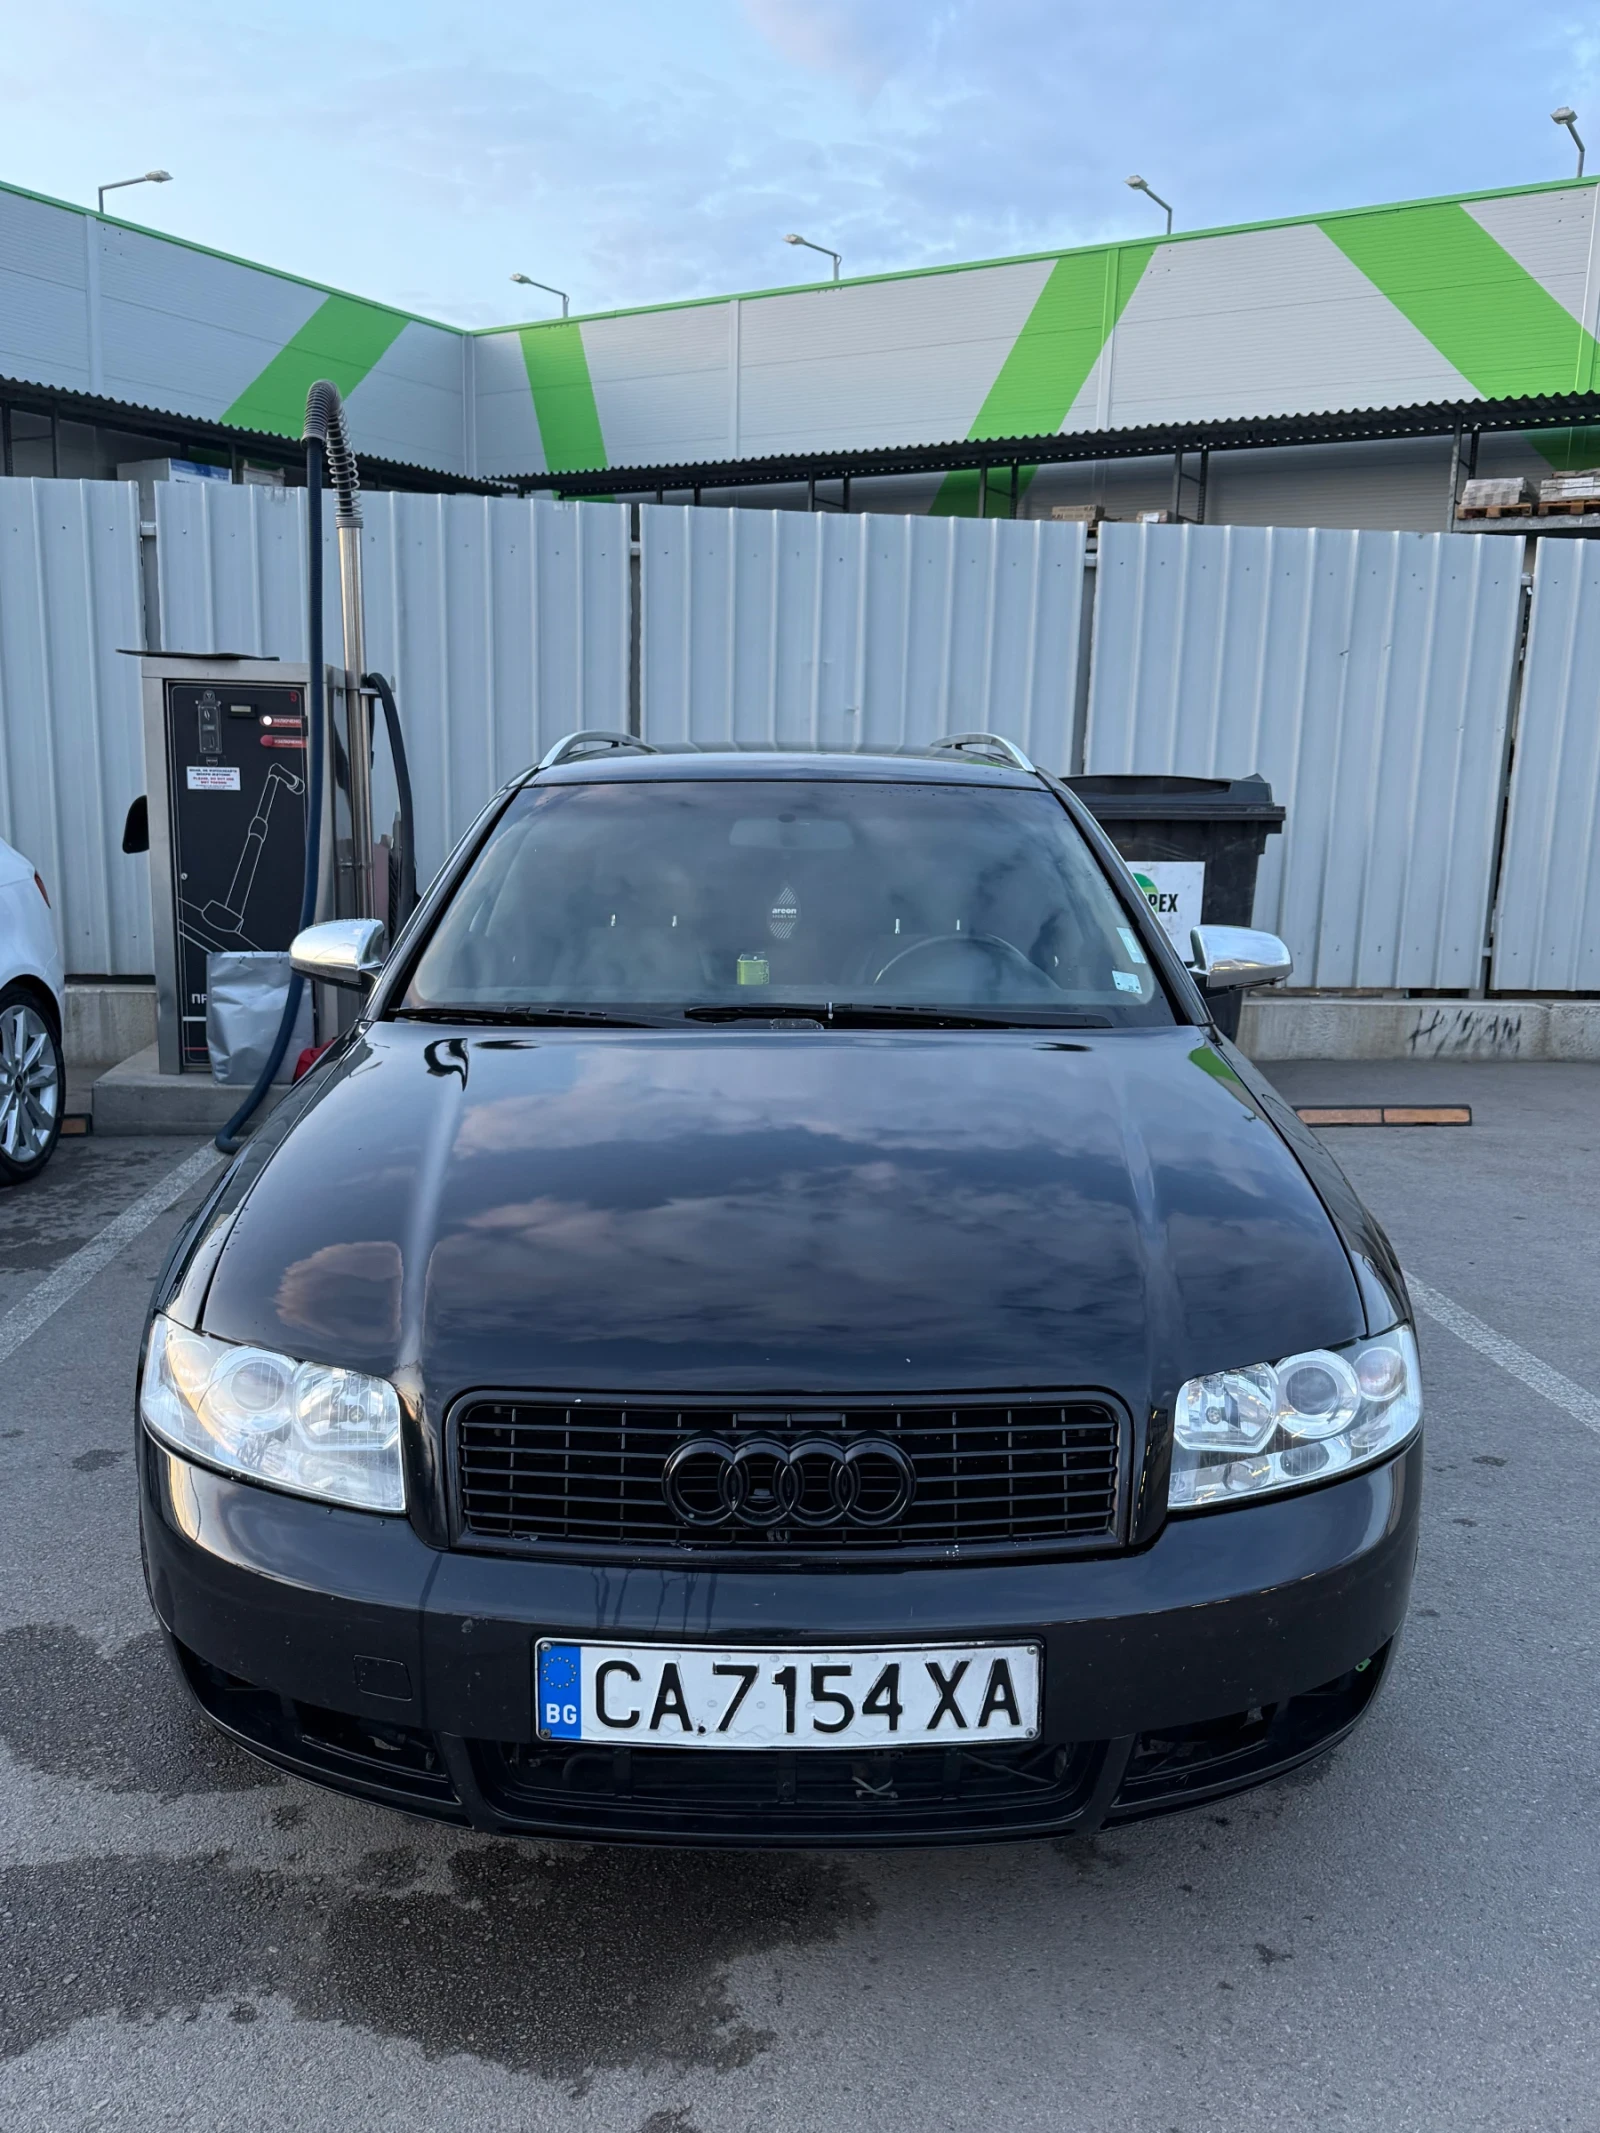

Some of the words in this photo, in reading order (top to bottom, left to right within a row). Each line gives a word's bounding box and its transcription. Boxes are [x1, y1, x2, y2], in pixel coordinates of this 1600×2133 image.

[290, 692, 297, 702] 5
[1146, 893, 1179, 913] PEX
[546, 1703, 577, 1725] BG
